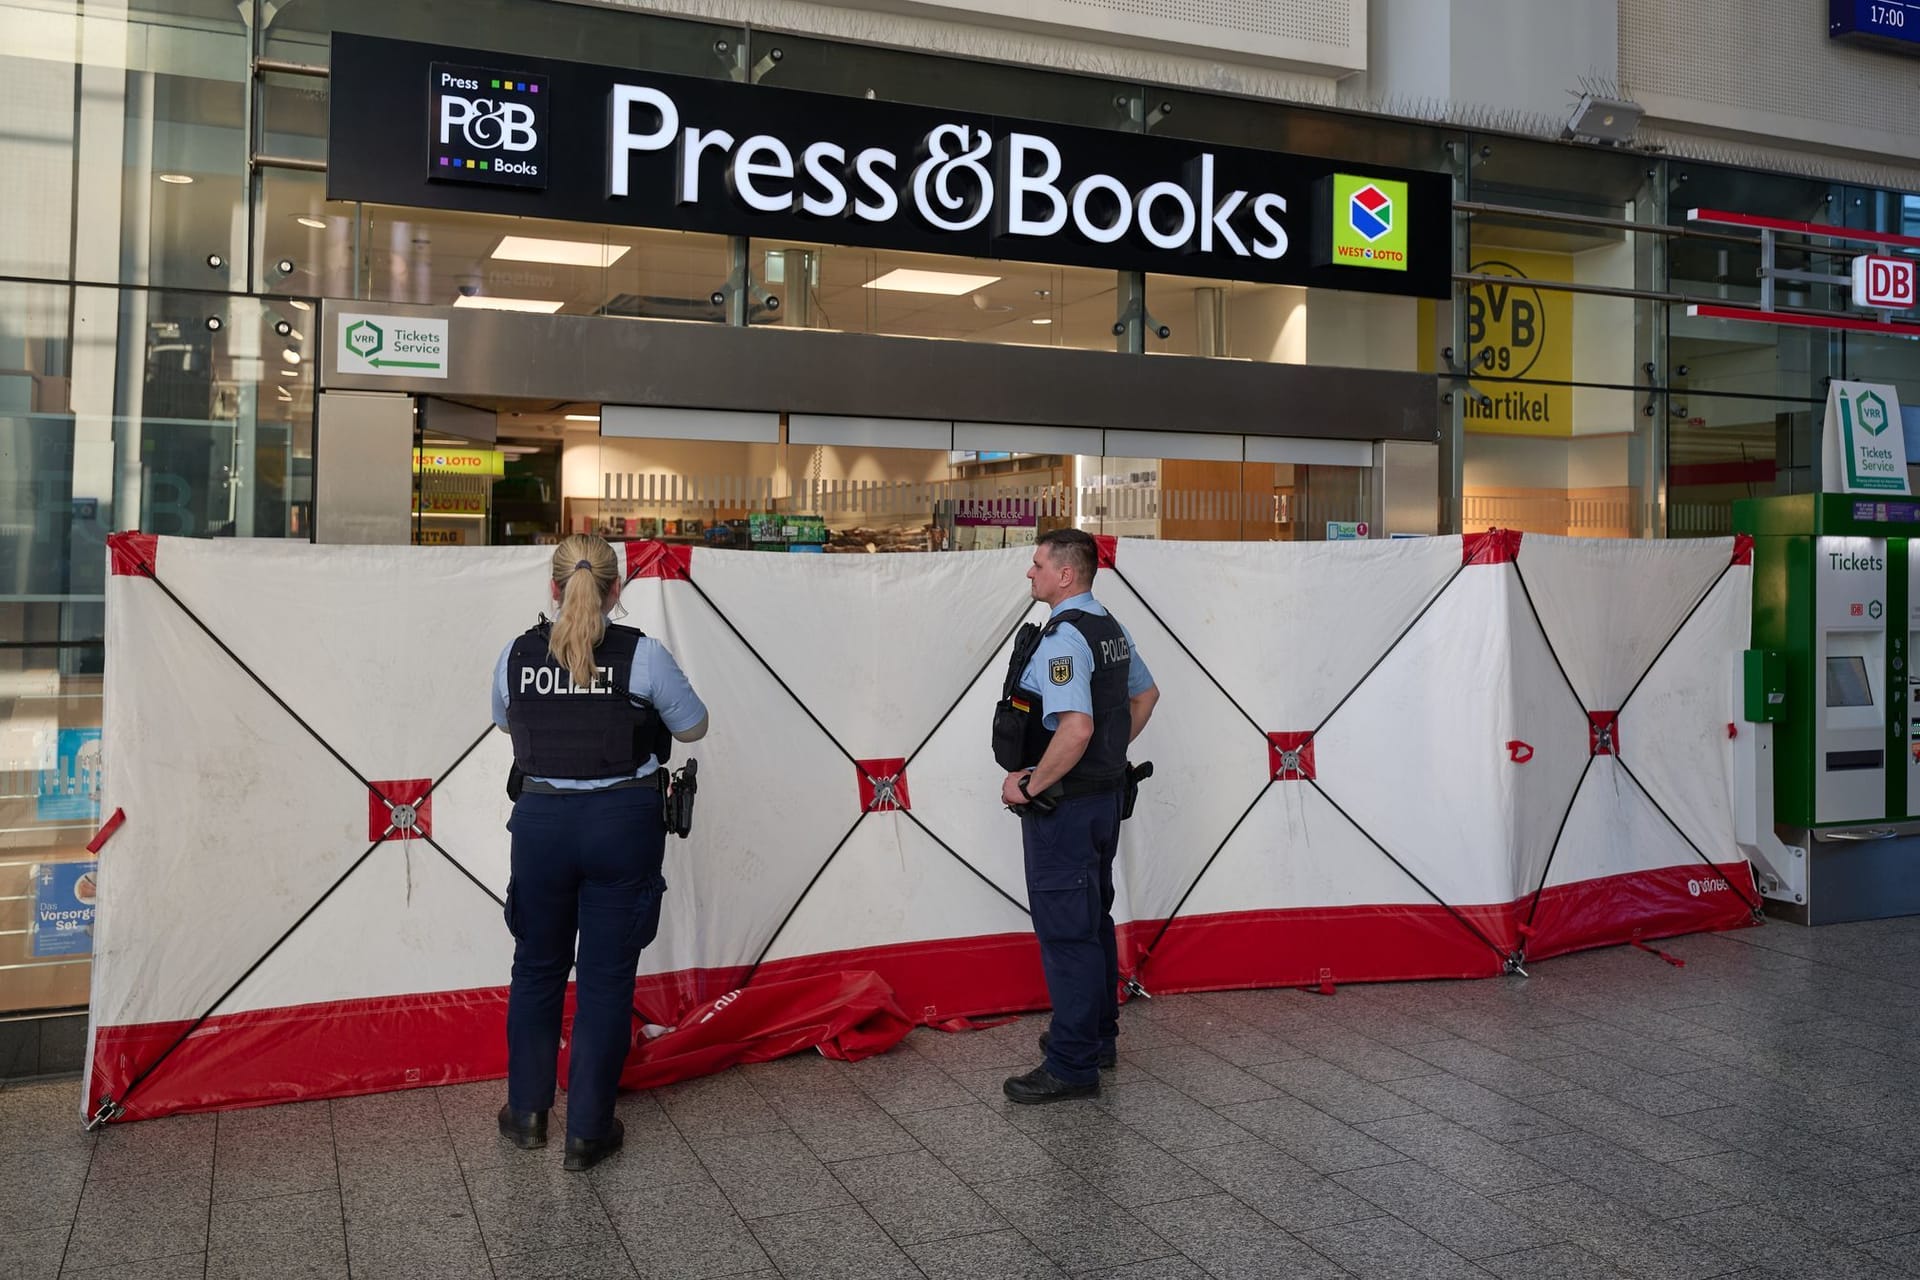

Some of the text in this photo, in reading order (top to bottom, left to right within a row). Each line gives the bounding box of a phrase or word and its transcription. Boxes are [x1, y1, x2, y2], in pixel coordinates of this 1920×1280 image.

[1871, 5, 1904, 27] 17:00
[441, 73, 479, 90] Press
[440, 94, 538, 152] P&B
[494, 158, 538, 176] Books
[1338, 246, 1403, 262] WEST LOTTO
[1872, 262, 1911, 299] DB
[1467, 272, 1536, 348] BVB
[354, 335, 375, 344] VRR
[394, 329, 440, 343] Tickets
[394, 341, 440, 354] Service
[1482, 345, 1511, 372] 09
[1863, 407, 1881, 419] VRR
[1860, 445, 1893, 460] Tickets
[446, 456, 482, 466] LOTTO
[1862, 459, 1895, 472] Service
[1829, 552, 1883, 571] Tickets
[40, 902, 58, 911] Das
[55, 920, 79, 931] Set
